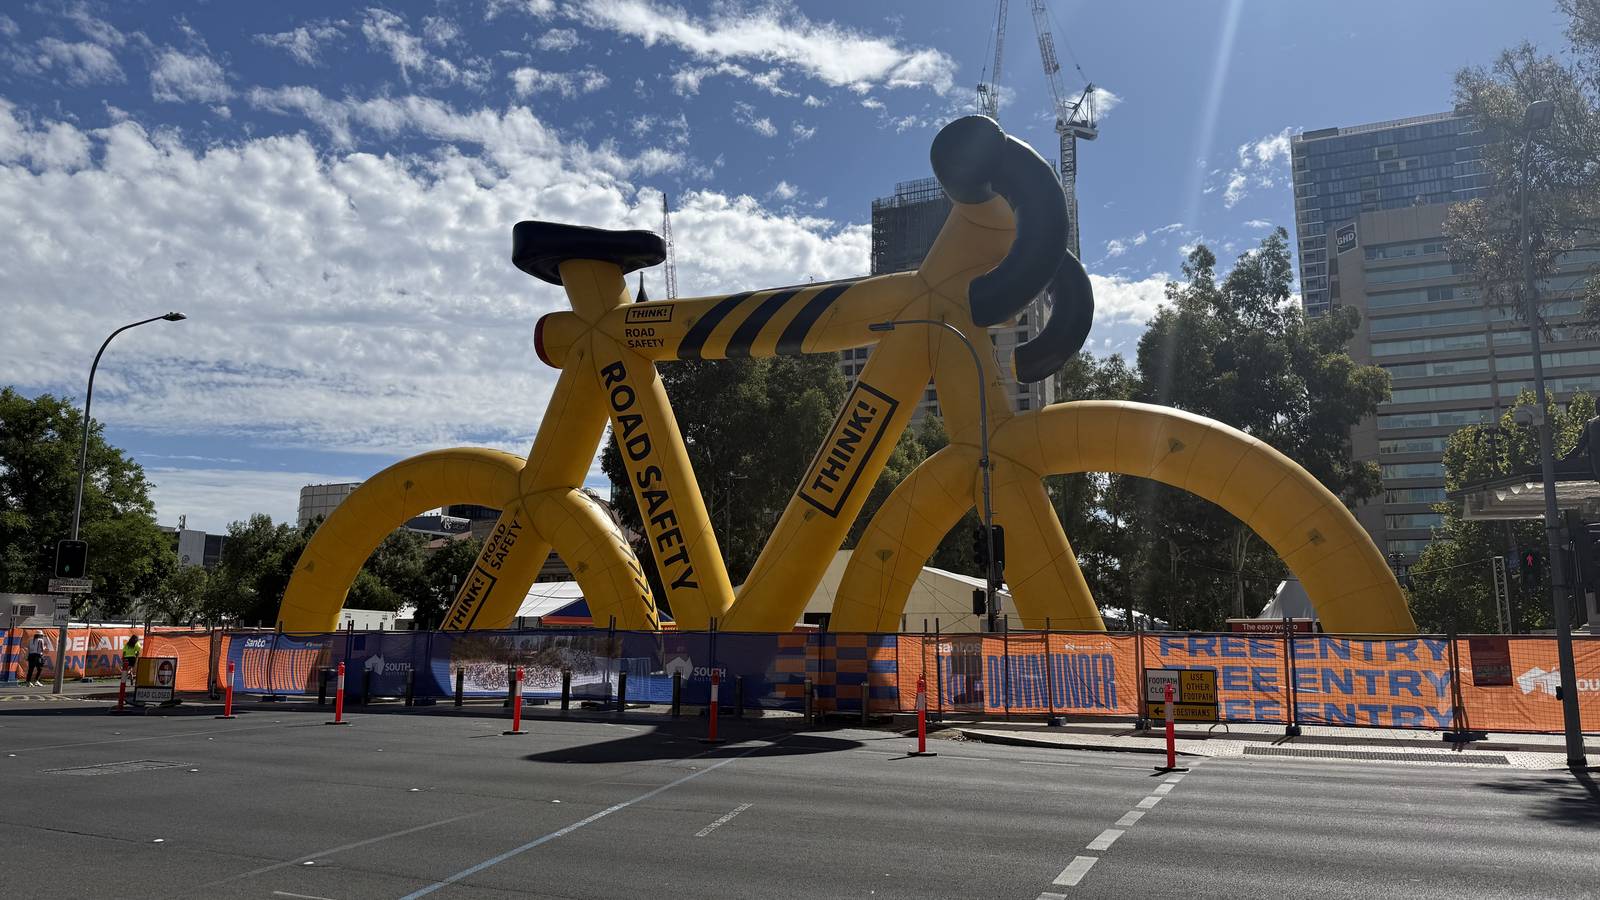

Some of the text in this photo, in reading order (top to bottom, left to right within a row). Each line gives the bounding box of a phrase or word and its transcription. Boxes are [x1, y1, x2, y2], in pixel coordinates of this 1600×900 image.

[1337, 232, 1355, 245] GHD
[632, 308, 668, 319] THINK!
[625, 327, 655, 338] ROAD
[627, 338, 665, 349] SAFETY
[811, 400, 878, 493] THINK!
[600, 360, 699, 590] ROAD SAFETY
[482, 523, 506, 563] ROAD
[490, 519, 522, 570] SAFETY
[448, 577, 485, 630] THINK!
[1242, 623, 1256, 631] The
[1256, 624, 1274, 632] easy
[1159, 636, 1452, 661] FREE ENTRY
[385, 662, 412, 672] SOUTH
[1050, 653, 1118, 710] UNDER
[1148, 677, 1178, 685] FOOTPATH
[1190, 672, 1205, 681] USE
[1295, 666, 1453, 698] ENTRY
[1186, 683, 1210, 691] OTHER
[137, 690, 171, 699] ROAD CLOSED
[1183, 692, 1214, 700] FOOTPATH
[1172, 708, 1210, 717] EDESTRIANS
[1296, 701, 1454, 728] ENTRY
